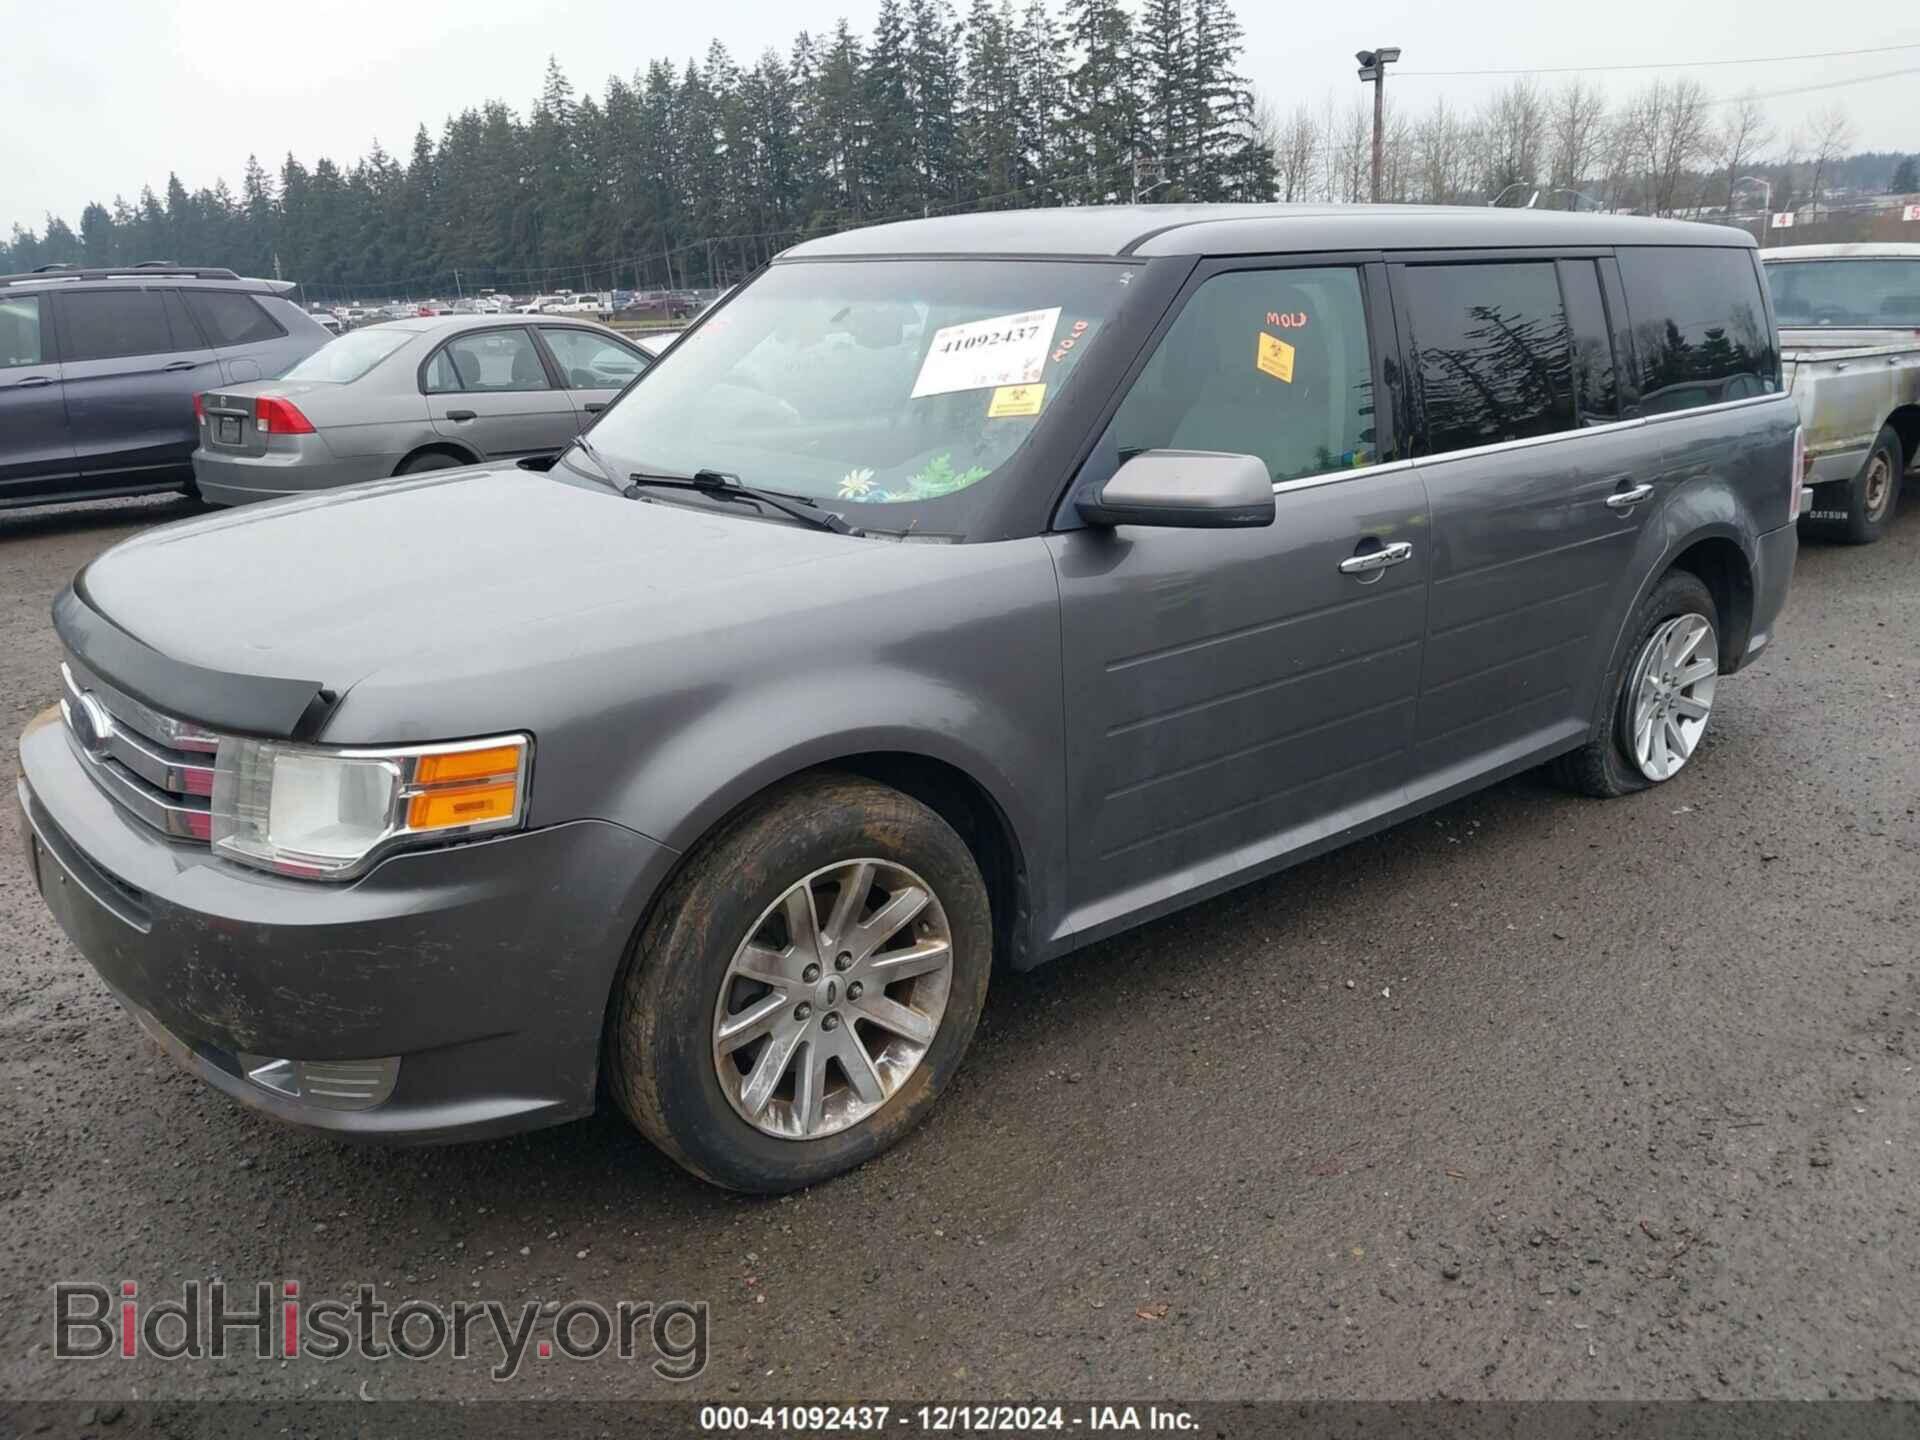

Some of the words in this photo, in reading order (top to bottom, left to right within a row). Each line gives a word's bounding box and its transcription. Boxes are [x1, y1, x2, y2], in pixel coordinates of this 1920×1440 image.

[1778, 214, 1787, 226] 4
[1265, 311, 1307, 328] MOLD
[938, 325, 1041, 354] 41092437
[1809, 510, 1849, 520] DATSUN
